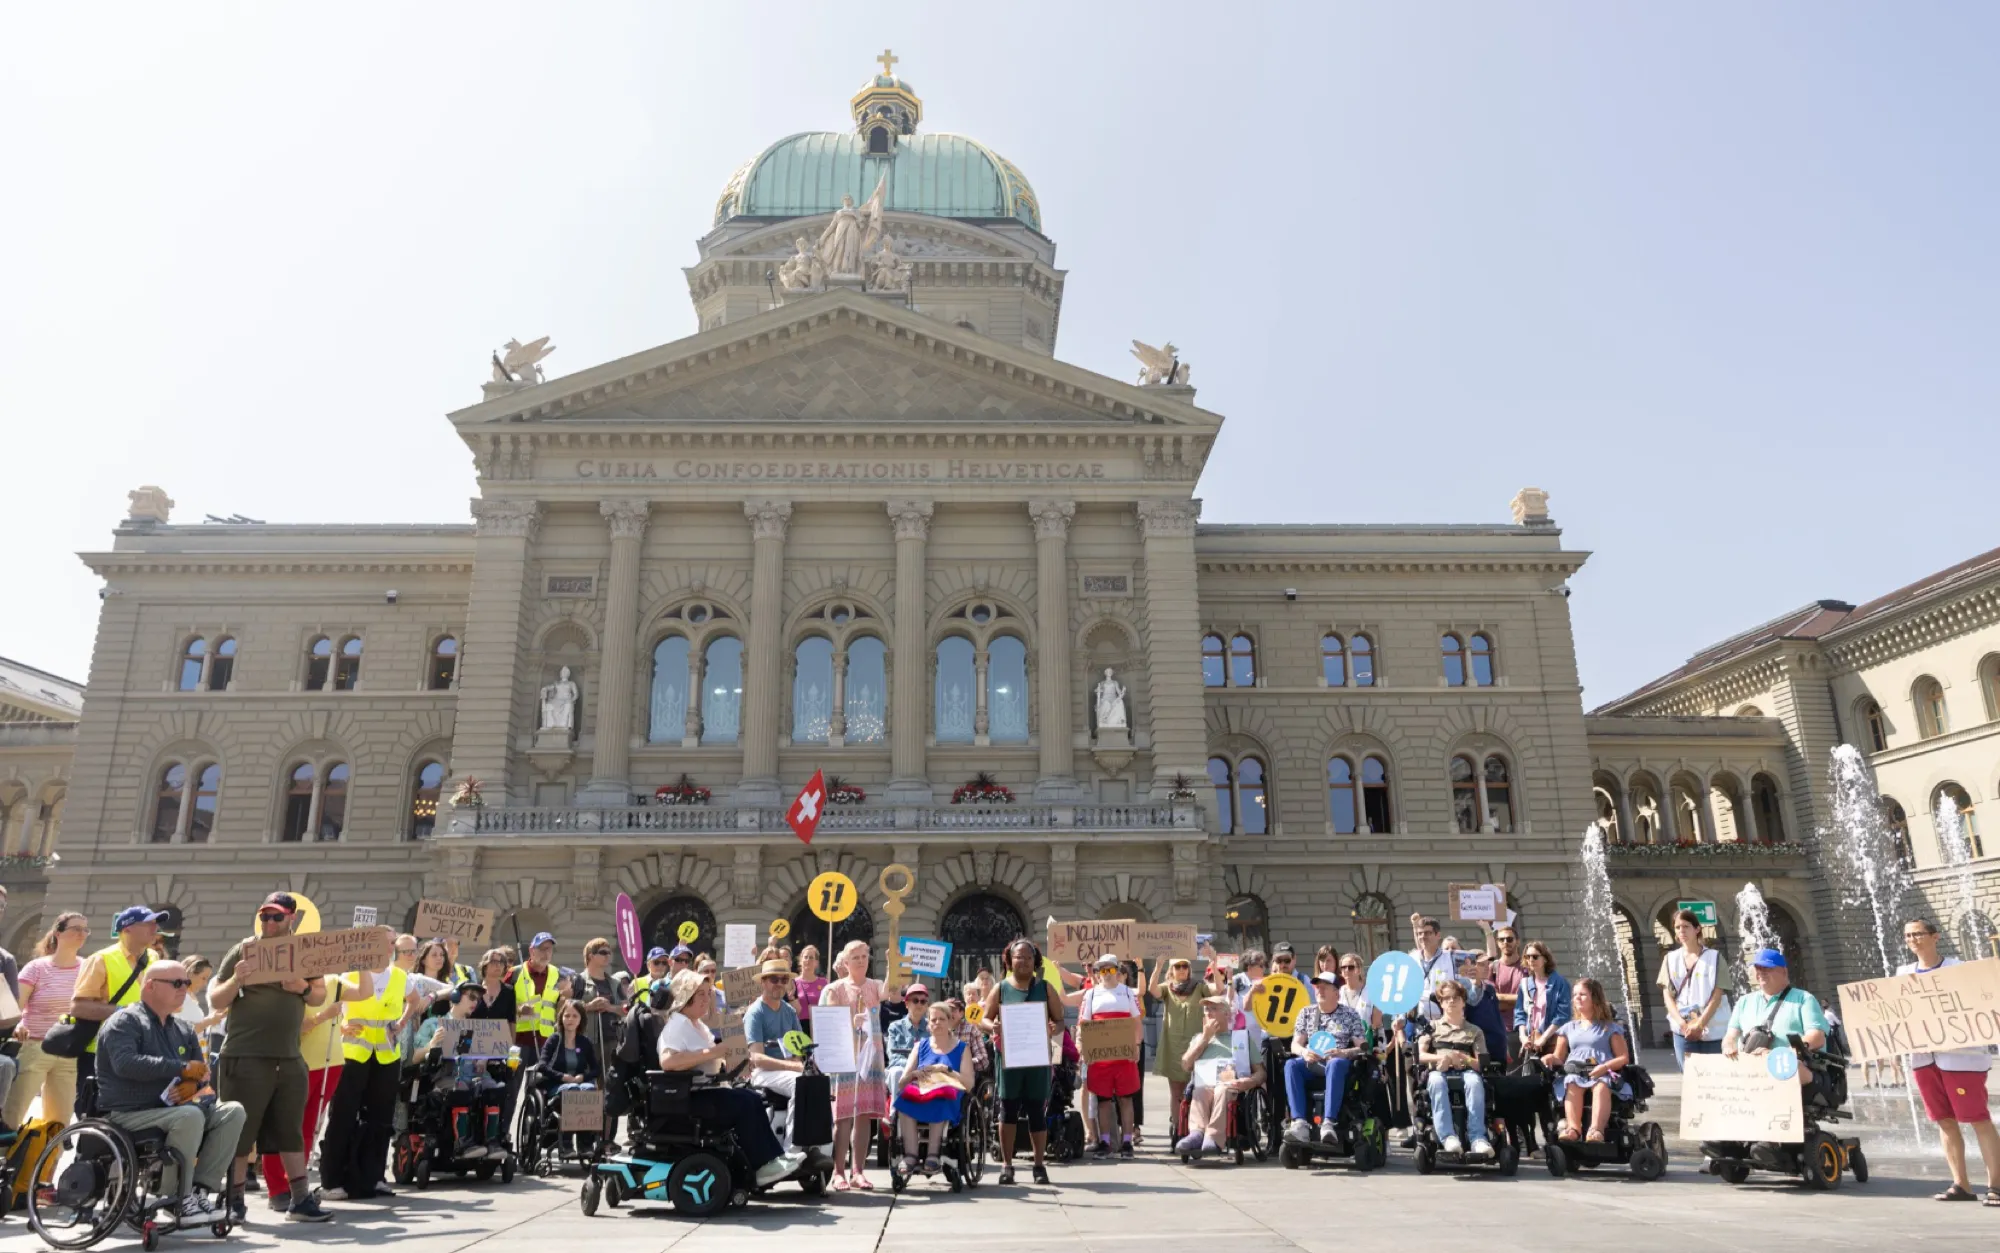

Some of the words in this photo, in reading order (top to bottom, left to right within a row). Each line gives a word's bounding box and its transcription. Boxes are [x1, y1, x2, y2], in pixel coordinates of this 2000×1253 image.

[575, 459, 658, 479] CURIA
[672, 459, 931, 479] CONFOEDERATIONIS
[947, 459, 1105, 479] HELVETICAE
[429, 916, 485, 942] JETZT!
[1380, 963, 1409, 1003] i!
[1845, 982, 1882, 1002] WIR
[1900, 975, 1945, 996] ALLE
[1266, 984, 1298, 1025] i!
[1866, 998, 1914, 1023] SIND
[1920, 991, 1974, 1015] TEIL
